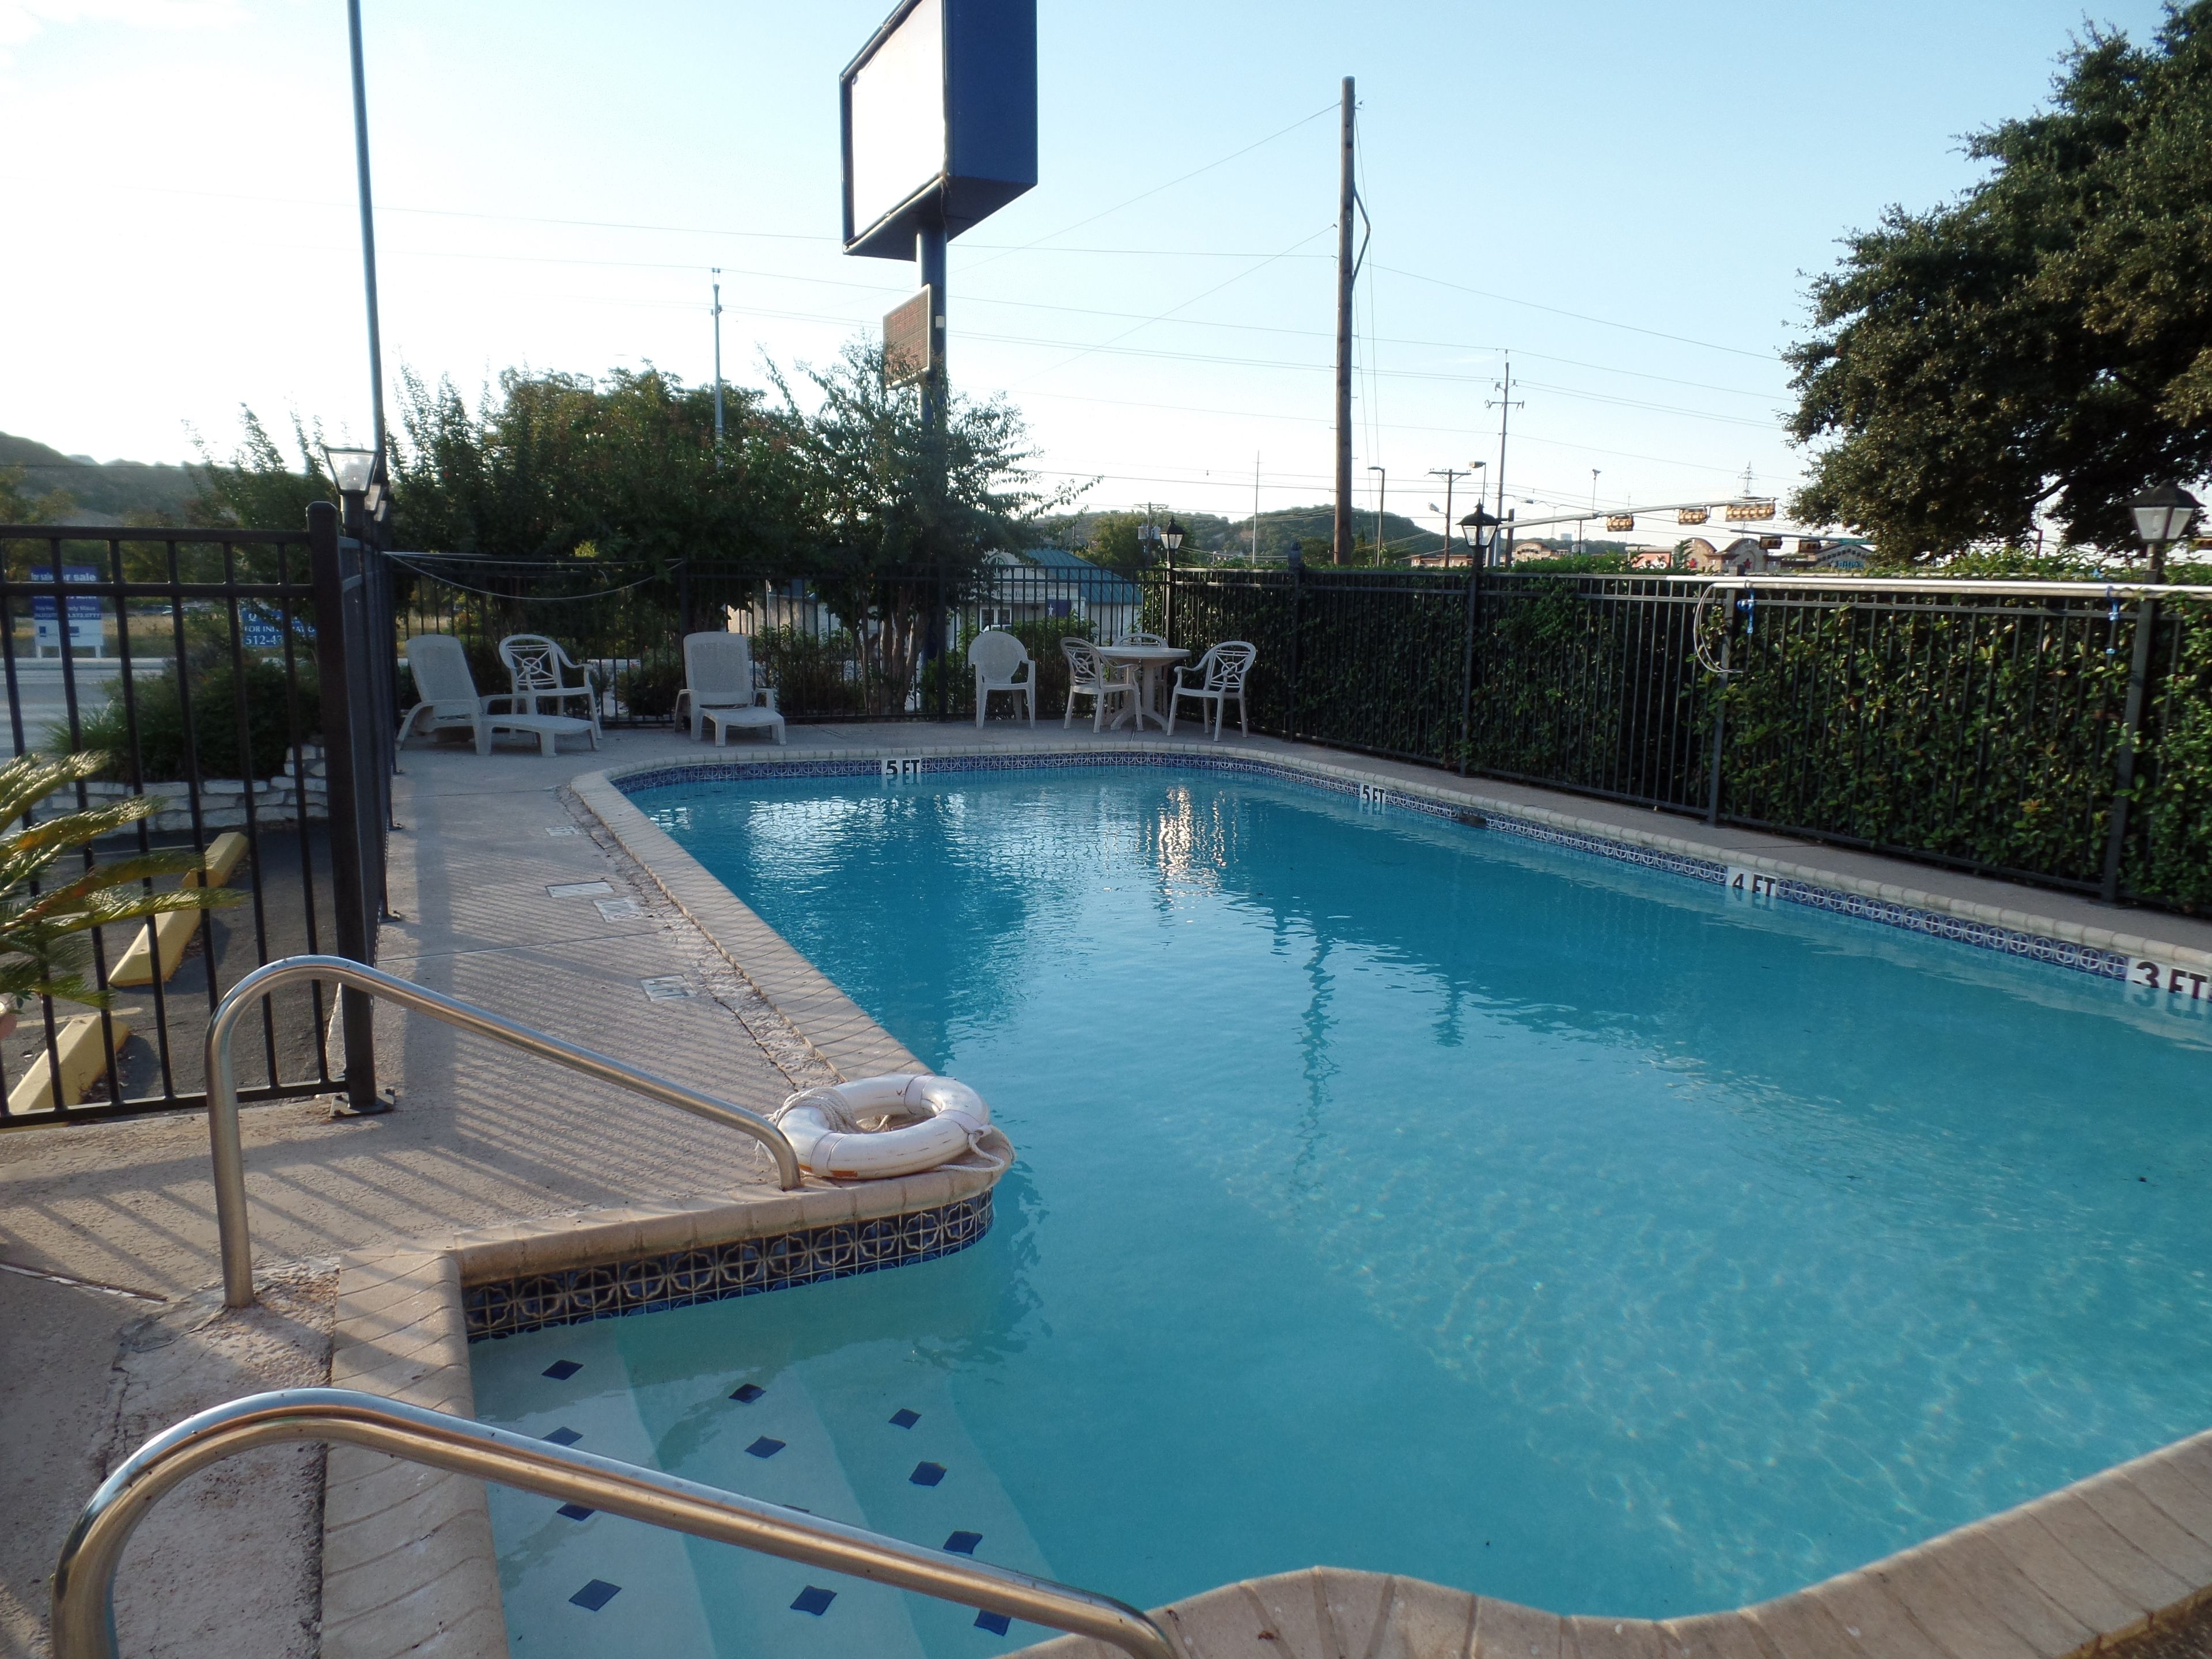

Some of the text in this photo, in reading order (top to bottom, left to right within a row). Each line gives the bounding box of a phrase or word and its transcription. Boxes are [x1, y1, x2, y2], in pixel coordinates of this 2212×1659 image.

[73, 573, 97, 581] sale
[886, 759, 920, 774] 5 FT
[1362, 784, 1385, 804] 5 FT
[1732, 873, 1777, 896] 4 FT
[2132, 961, 2208, 999] 3 FT
